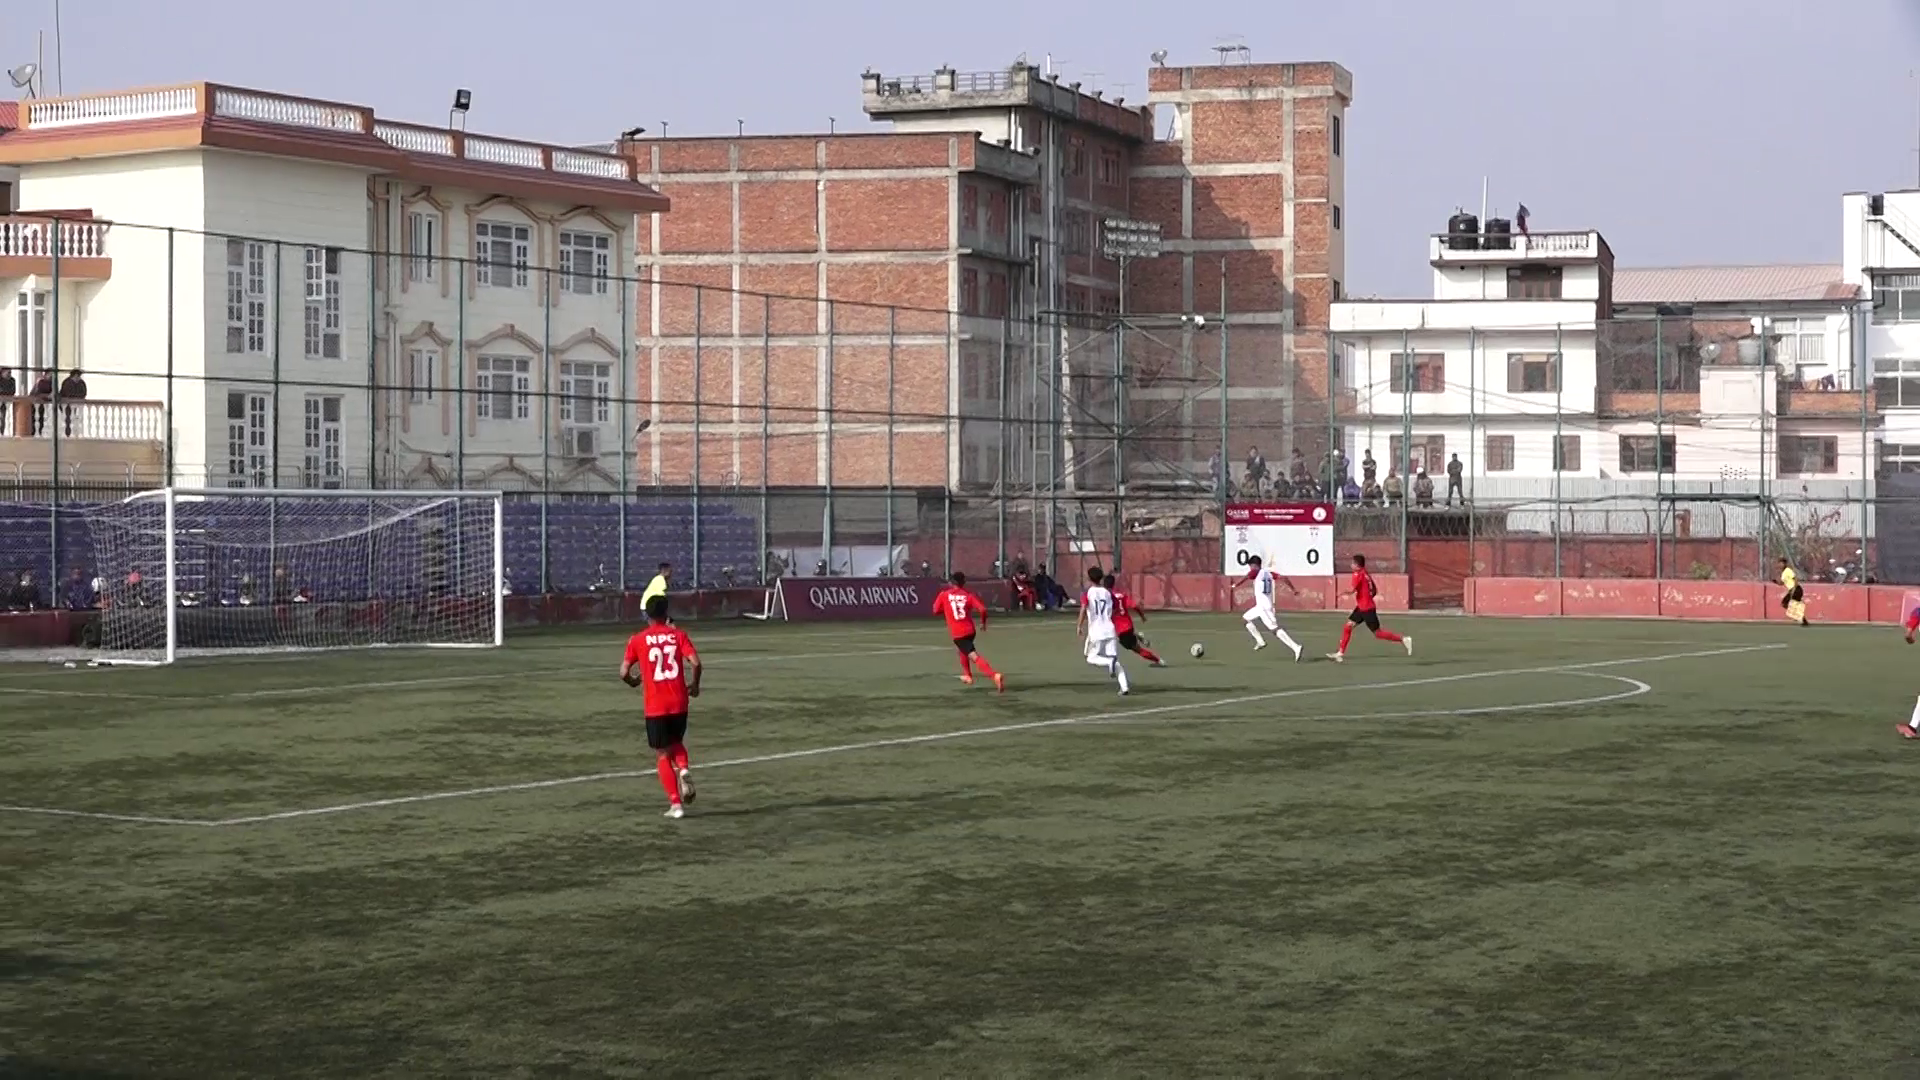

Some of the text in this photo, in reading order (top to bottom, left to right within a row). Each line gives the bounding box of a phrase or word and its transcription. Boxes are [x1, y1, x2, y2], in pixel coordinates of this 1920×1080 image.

[1237, 549, 1249, 566] 0
[1307, 548, 1319, 565] 0
[809, 585, 919, 610] QATAR AIRWAYS
[949, 600, 966, 620] 13
[1094, 598, 1107, 615] 17
[645, 632, 677, 646] NPC
[648, 645, 679, 682] 23
